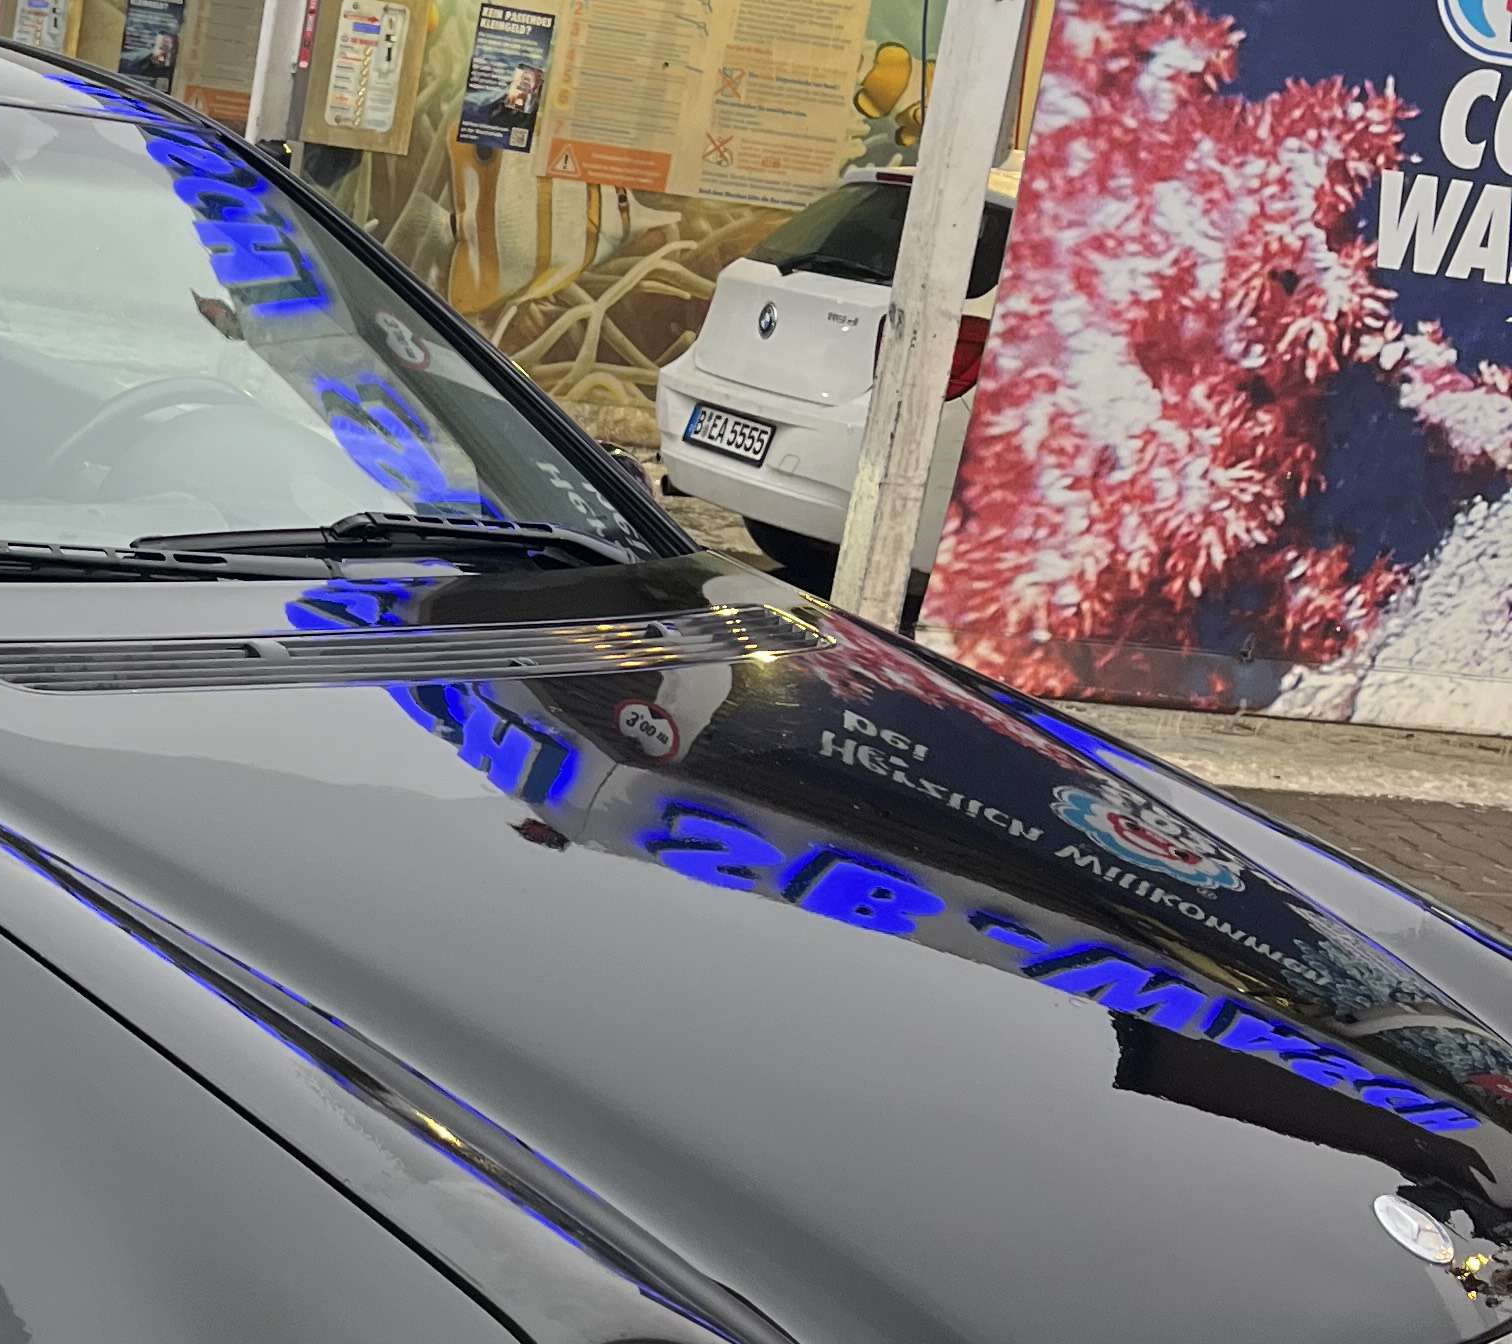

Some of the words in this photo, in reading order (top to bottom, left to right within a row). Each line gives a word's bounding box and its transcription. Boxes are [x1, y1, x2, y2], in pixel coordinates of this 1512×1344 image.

[1440, 68, 1512, 177] C
[1377, 169, 1512, 285] WA
[694, 410, 707, 435] B
[708, 414, 729, 444] EA
[727, 421, 769, 455] 5555
